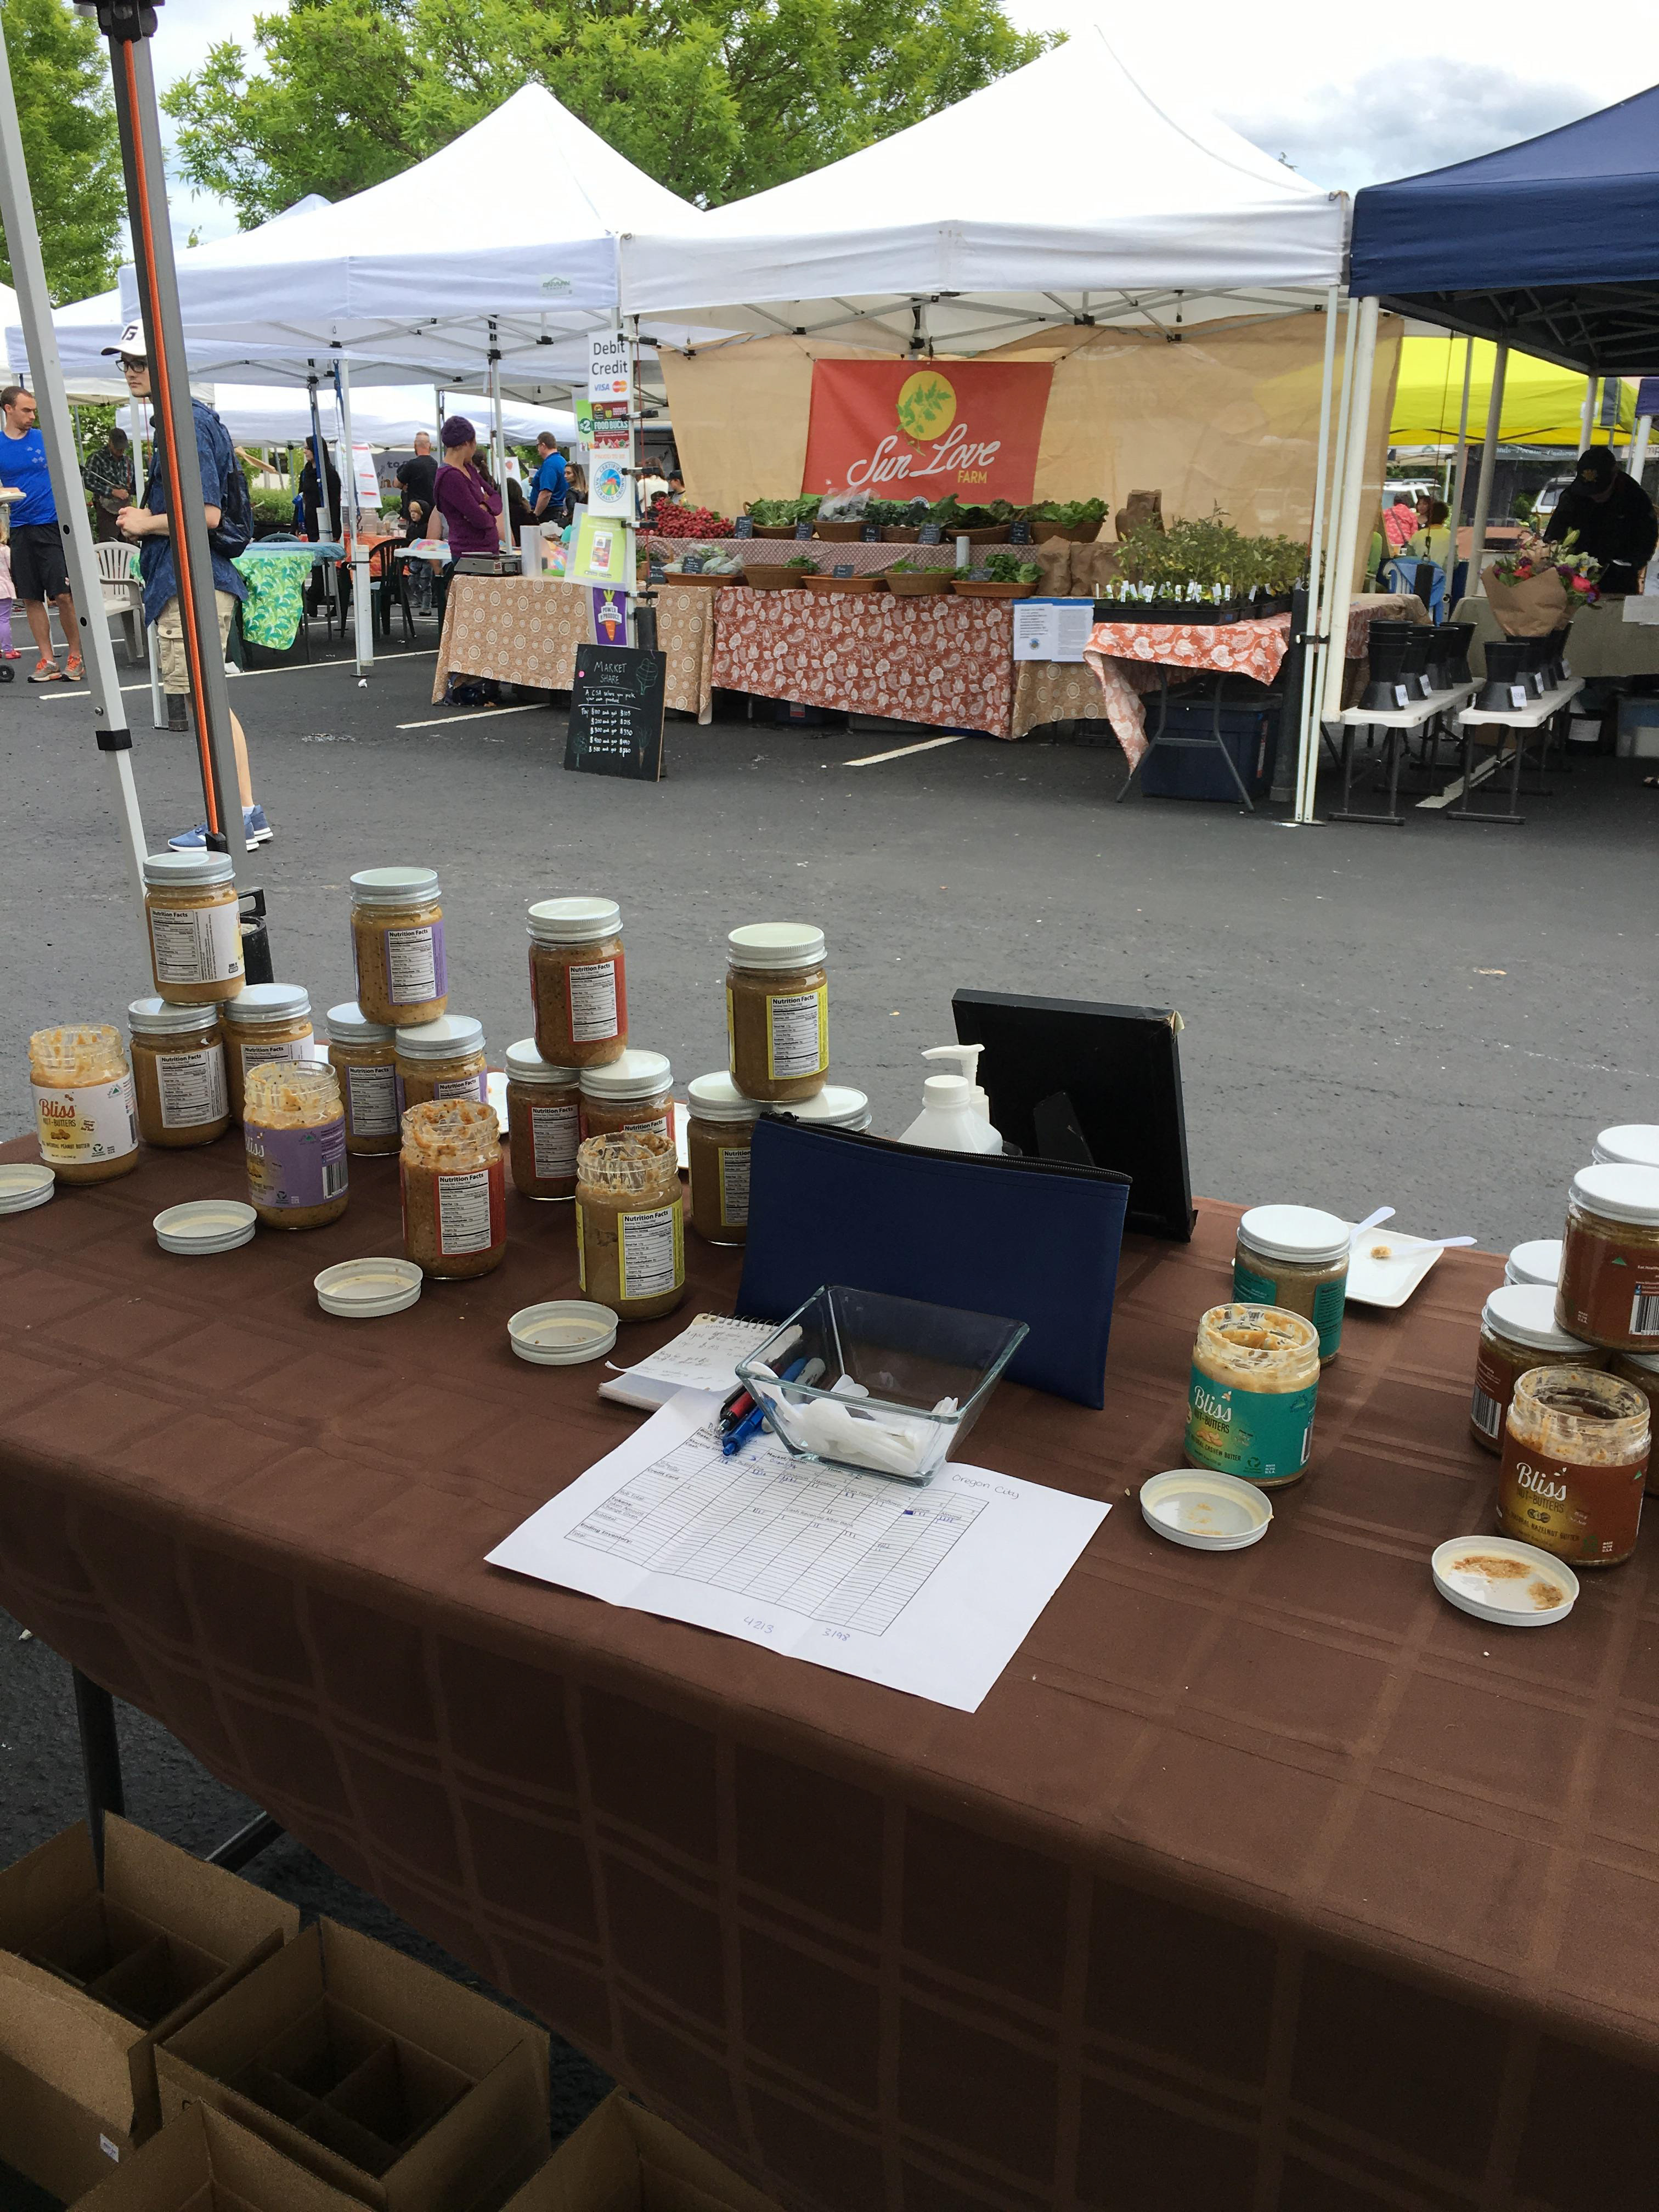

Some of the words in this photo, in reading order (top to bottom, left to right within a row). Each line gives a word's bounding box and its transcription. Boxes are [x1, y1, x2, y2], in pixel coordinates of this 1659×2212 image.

[593, 341, 625, 355] Debit
[591, 360, 628, 375] Credit
[594, 383, 610, 392] VISA
[579, 420, 591, 432] $2
[594, 421, 609, 430] FOOD
[610, 420, 628, 428] BUCKS
[847, 435, 912, 486] Sun
[910, 423, 1001, 477] Love
[957, 470, 988, 484] FARM
[595, 477, 614, 501] NATURALLY
[594, 661, 627, 673] MARKET
[600, 674, 620, 685] SHARE
[39, 1098, 76, 1119] Bliss
[624, 1123, 651, 1131] Nutrition
[651, 1119, 663, 1127] Facts
[654, 1210, 668, 1218] Facts
[1194, 1385, 1232, 1422] Bliss
[1205, 1444, 1223, 1457] CASHEW
[1224, 1452, 1242, 1462] BUTTER
[952, 1474, 990, 1489] Oregon
[994, 1485, 1020, 1500] City
[1516, 1462, 1567, 1502] Bliss
[579, 1522, 601, 1534] Ending
[601, 1529, 633, 1544] Inventory:
[743, 1616, 774, 1634] 4213
[822, 1627, 851, 1642] 3198
